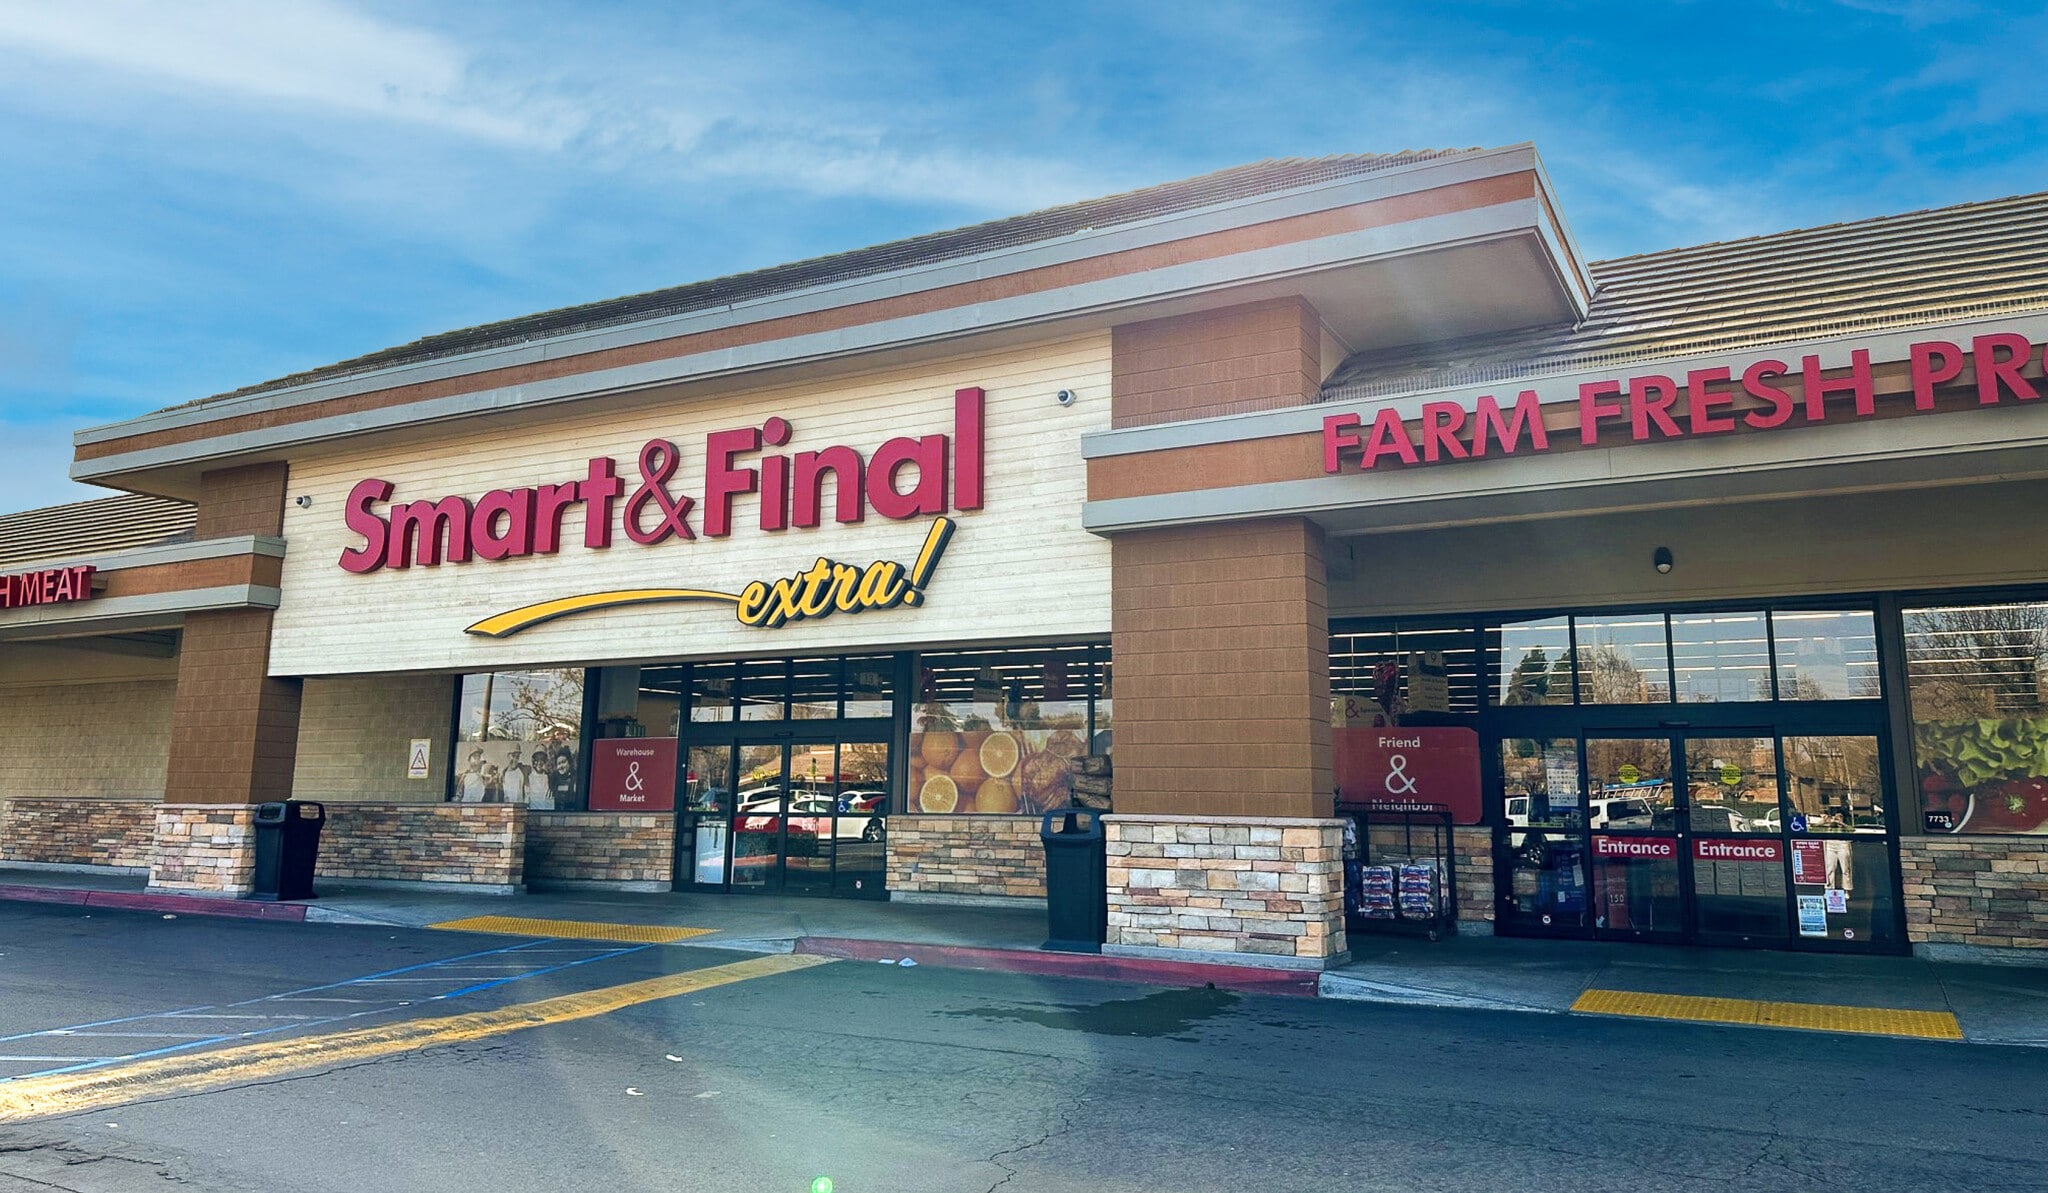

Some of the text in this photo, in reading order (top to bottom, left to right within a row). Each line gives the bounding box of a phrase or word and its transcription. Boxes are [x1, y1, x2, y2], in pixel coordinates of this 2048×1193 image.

[1322, 332, 2048, 474] FARM FRESH PR
[735, 516, 957, 629] extra!
[19, 565, 91, 606] MEAT
[616, 747, 655, 757] Warehouse
[1378, 736, 1421, 749] Friend
[625, 761, 643, 791] &
[1385, 754, 1418, 795] &
[619, 794, 645, 803] Market
[1928, 815, 1950, 824] 7733
[1598, 838, 1671, 856] Entrance
[1698, 839, 1776, 858] Entrance
